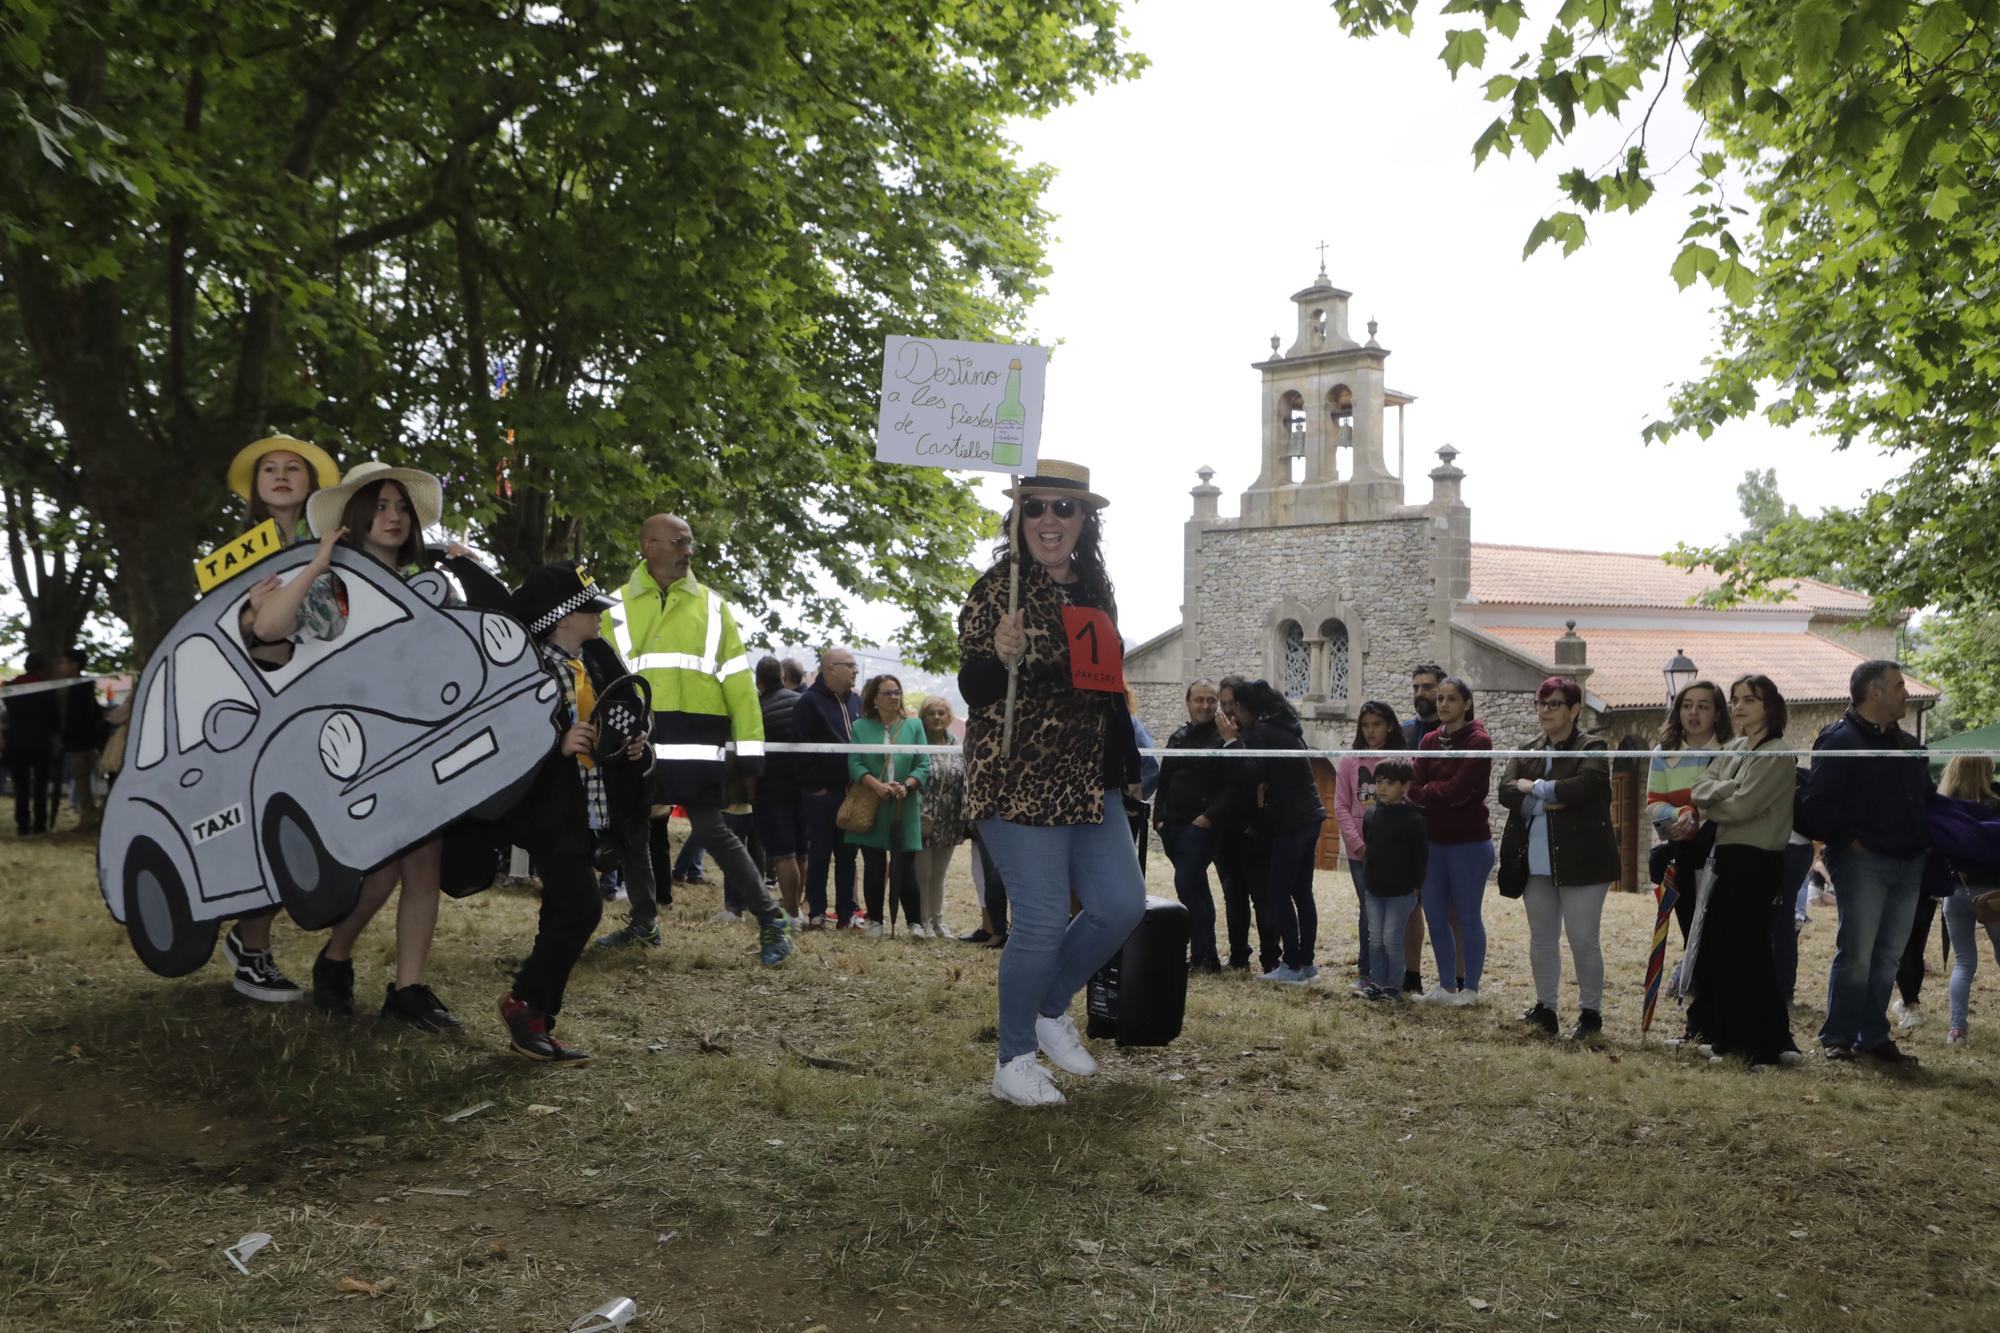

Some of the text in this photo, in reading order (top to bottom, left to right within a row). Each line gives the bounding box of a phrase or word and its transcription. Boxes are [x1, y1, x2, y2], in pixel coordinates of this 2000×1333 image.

[895, 341, 1001, 385] Destino
[887, 391, 901, 402] a
[911, 385, 946, 409] les
[894, 412, 991, 461] de Castiello
[205, 531, 269, 577] TAXI
[1075, 621, 1100, 665] 1
[192, 807, 241, 840] TAXI
